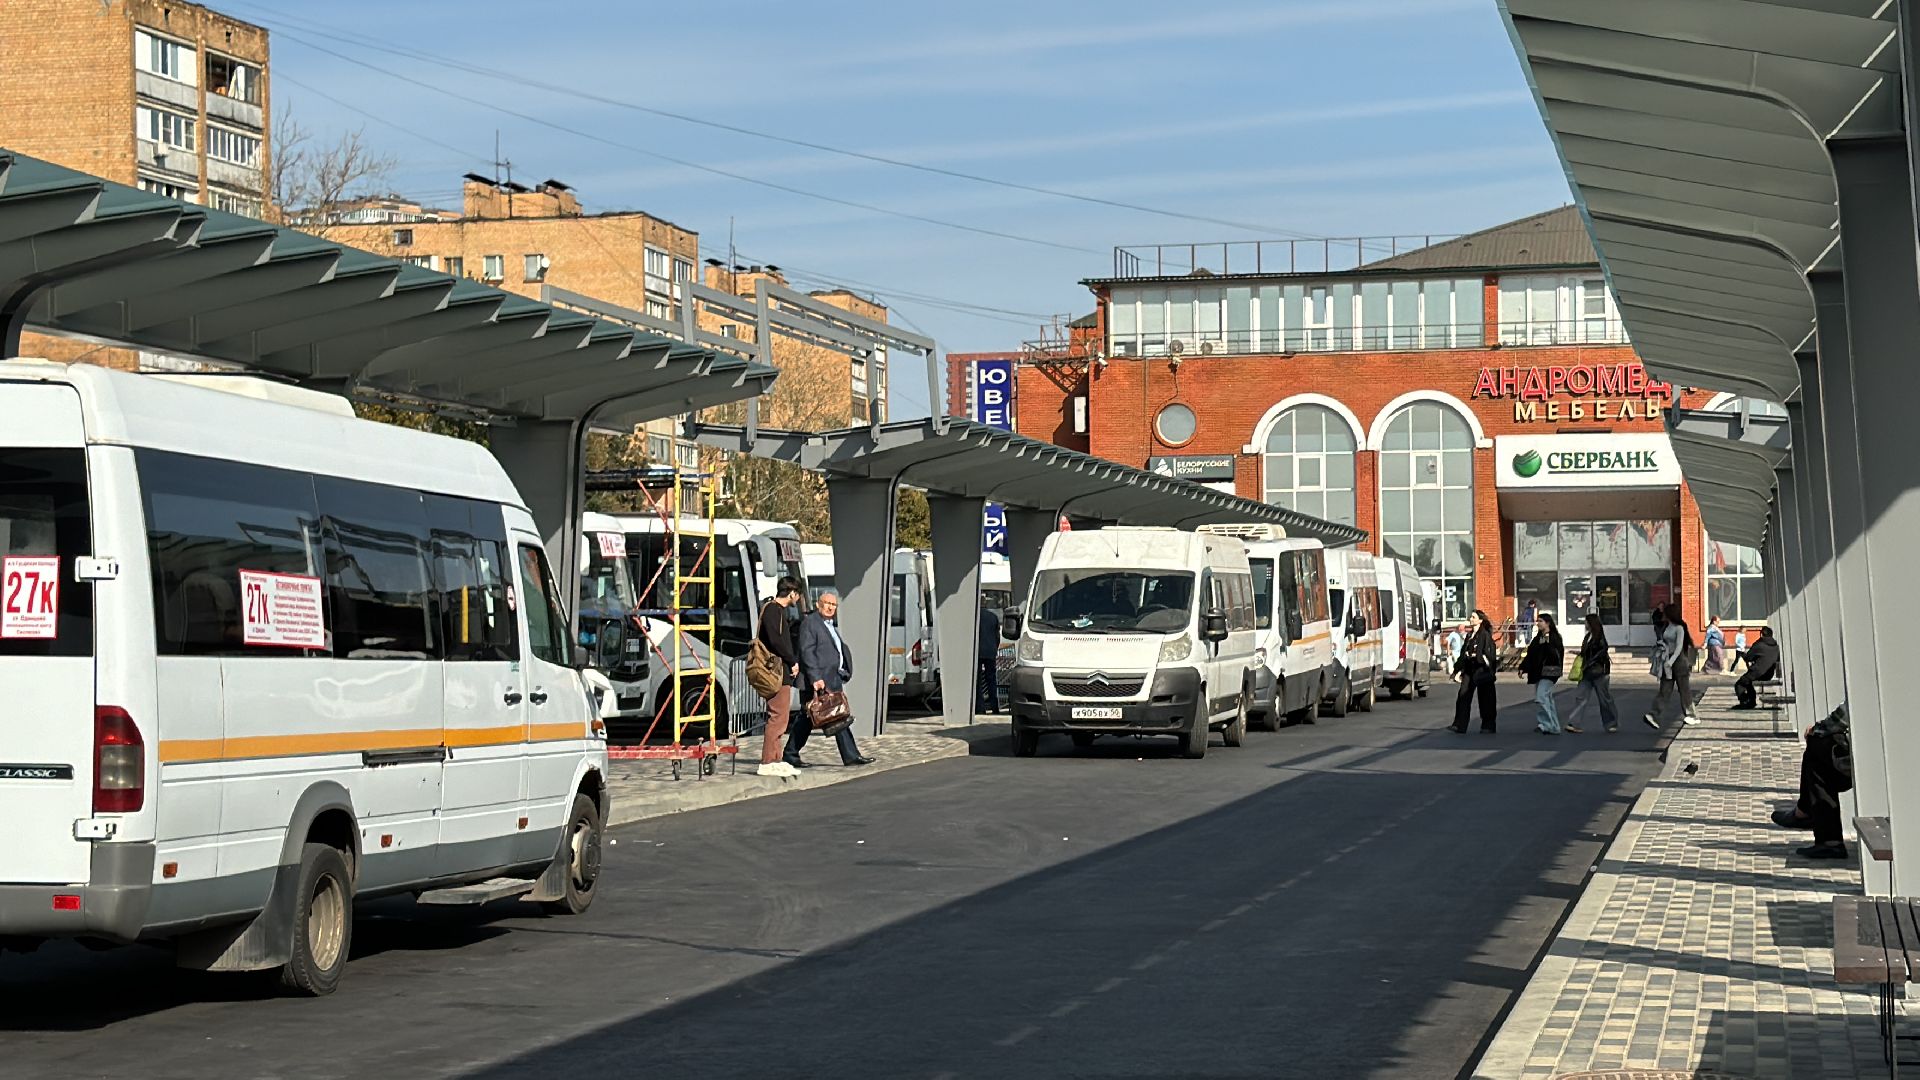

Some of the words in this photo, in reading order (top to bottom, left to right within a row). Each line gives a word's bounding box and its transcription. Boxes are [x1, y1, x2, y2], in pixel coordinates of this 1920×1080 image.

[1473, 364, 1697, 399] АНДРОМЕД
[1515, 400, 1660, 420] МЕБЕЛЬ
[1177, 460, 1230, 468] БЕЛОРУССКИЕ
[1547, 451, 1657, 469] СБЕРБАНК
